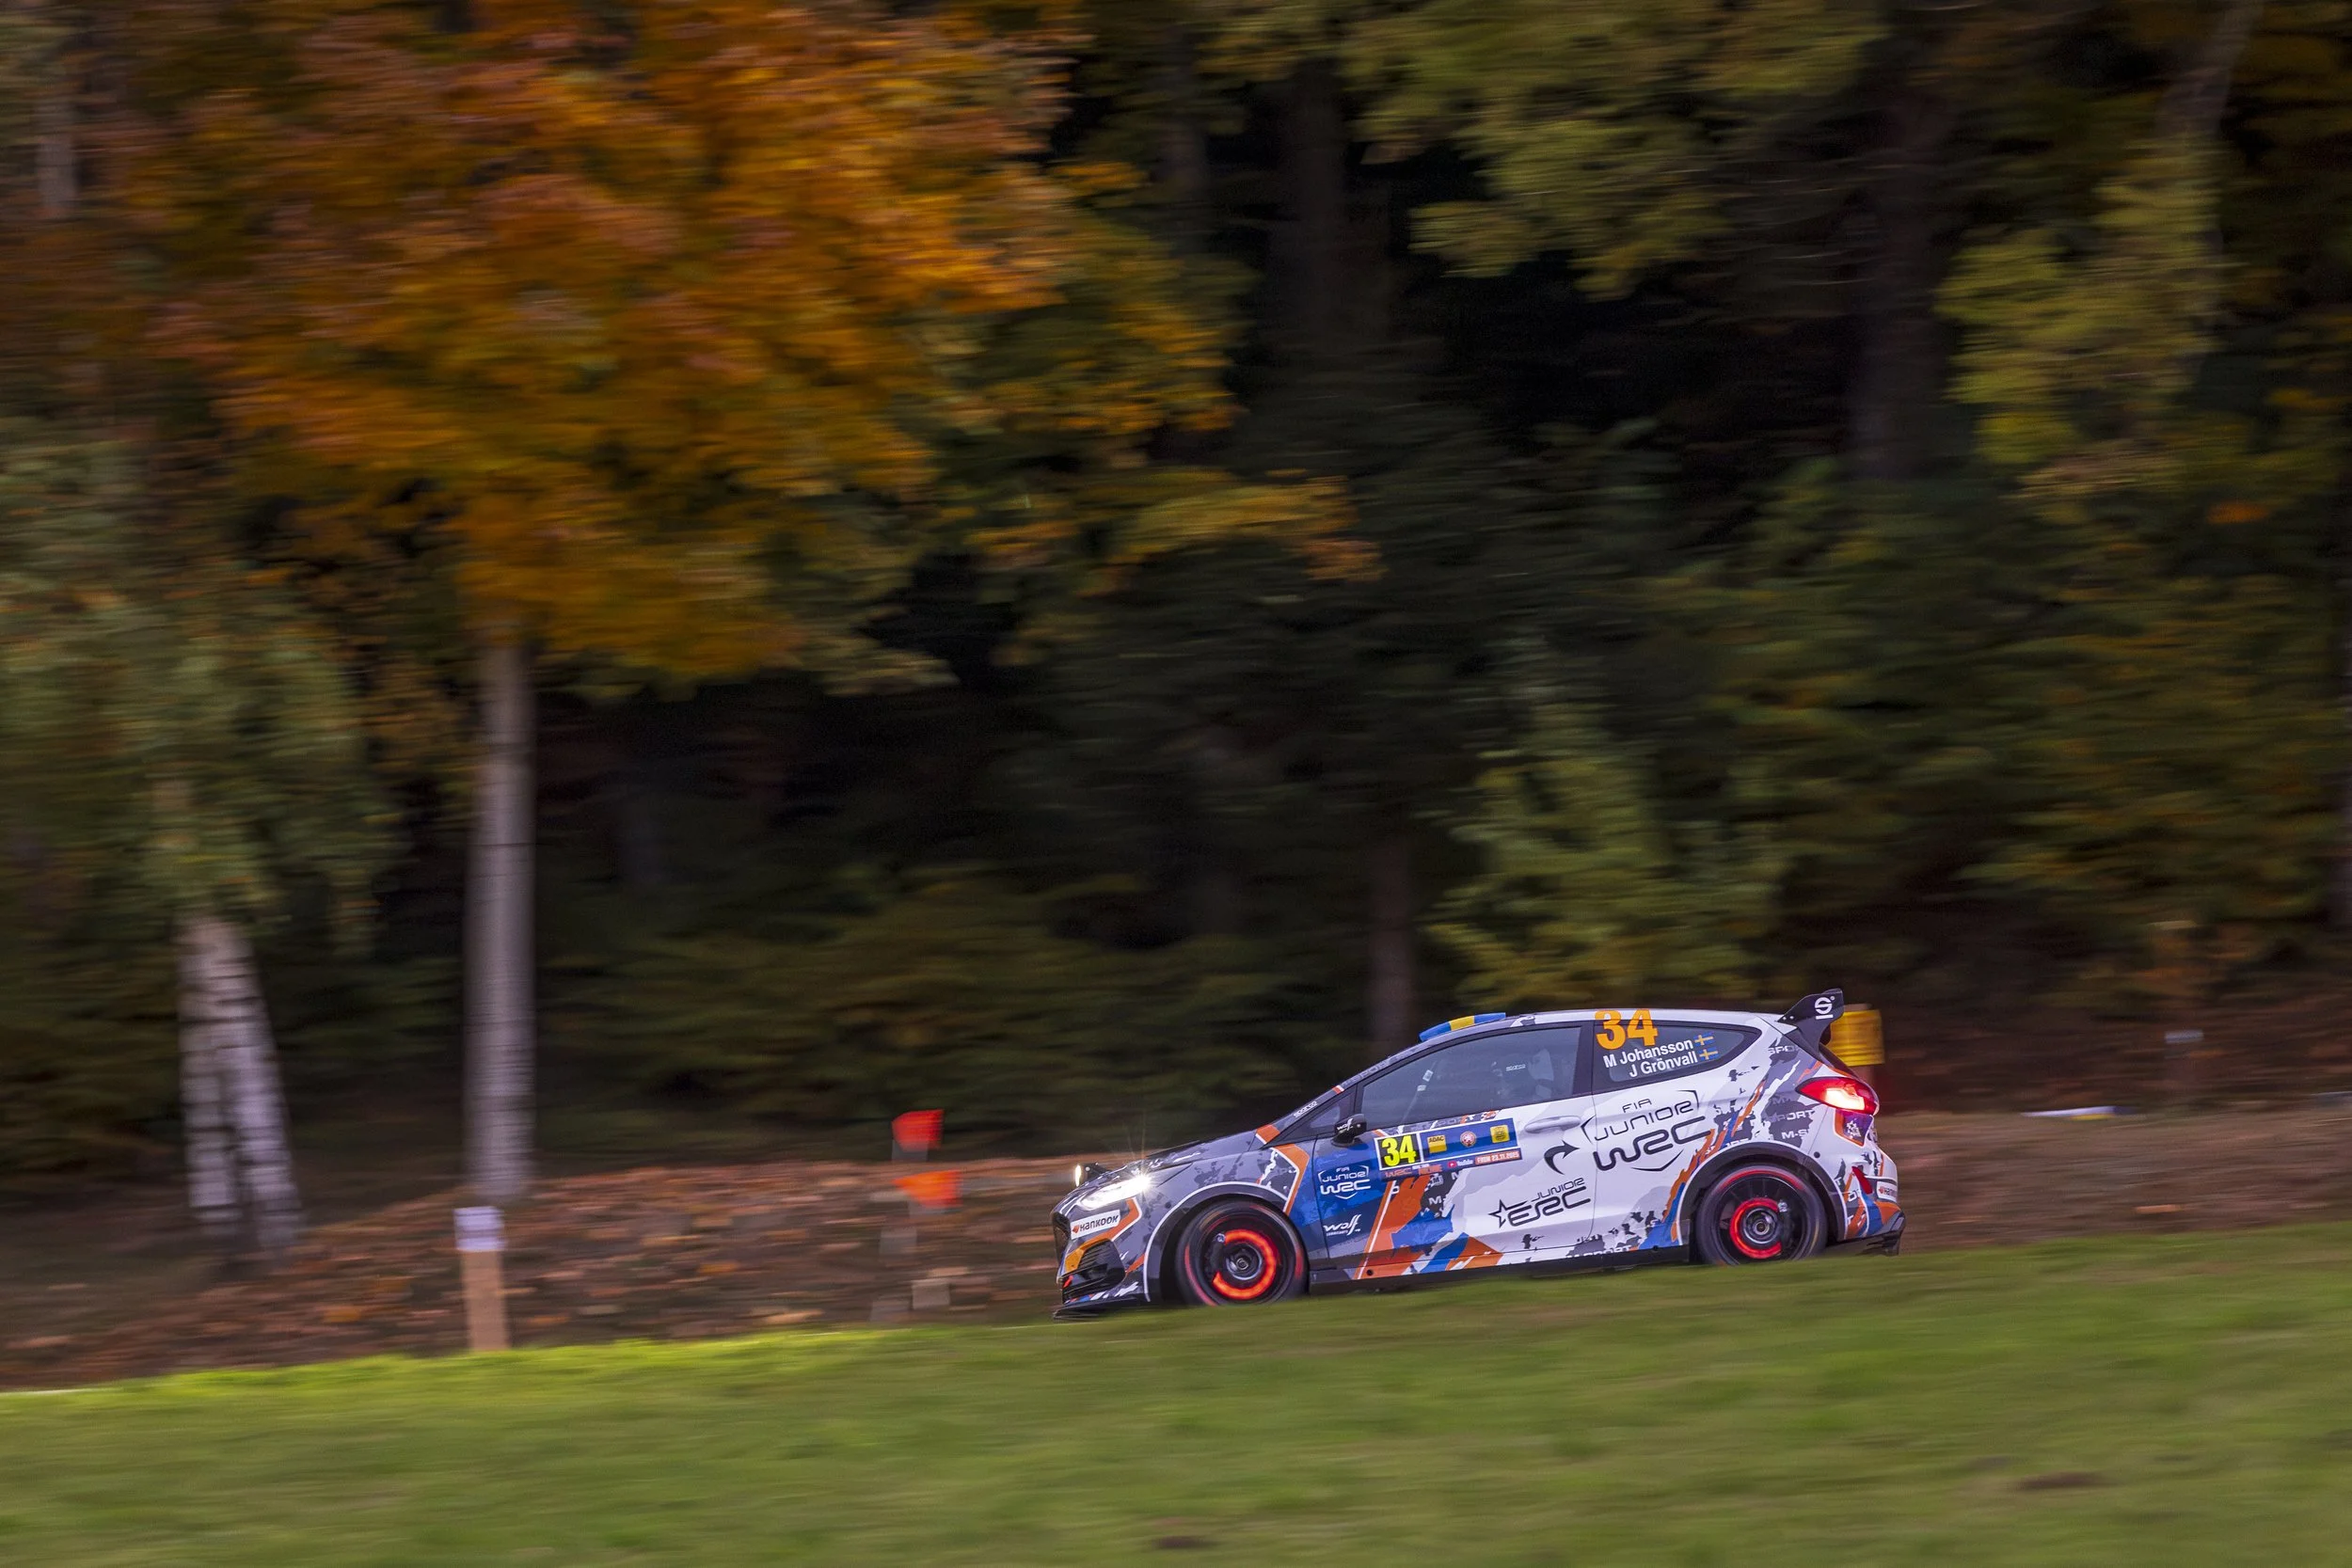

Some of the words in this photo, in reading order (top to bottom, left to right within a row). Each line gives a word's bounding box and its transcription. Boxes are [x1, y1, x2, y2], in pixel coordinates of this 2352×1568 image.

[1595, 1008, 1659, 1050] 34
[1602, 1053, 1617, 1069] M
[1620, 1039, 1693, 1065] Johansson
[1629, 1064, 1638, 1078] J
[1640, 1051, 1698, 1074] Grönvall
[1622, 1098, 1653, 1113] FIA
[1594, 1101, 1693, 1141] JUNIOR
[1381, 1134, 1417, 1167] 34
[1593, 1116, 1711, 1171] WRC
[1320, 1179, 1371, 1195] WRC
[1322, 1170, 1366, 1182] JUNIOR
[1531, 1177, 1584, 1202] JUNIOR
[1507, 1185, 1591, 1227] ERC
